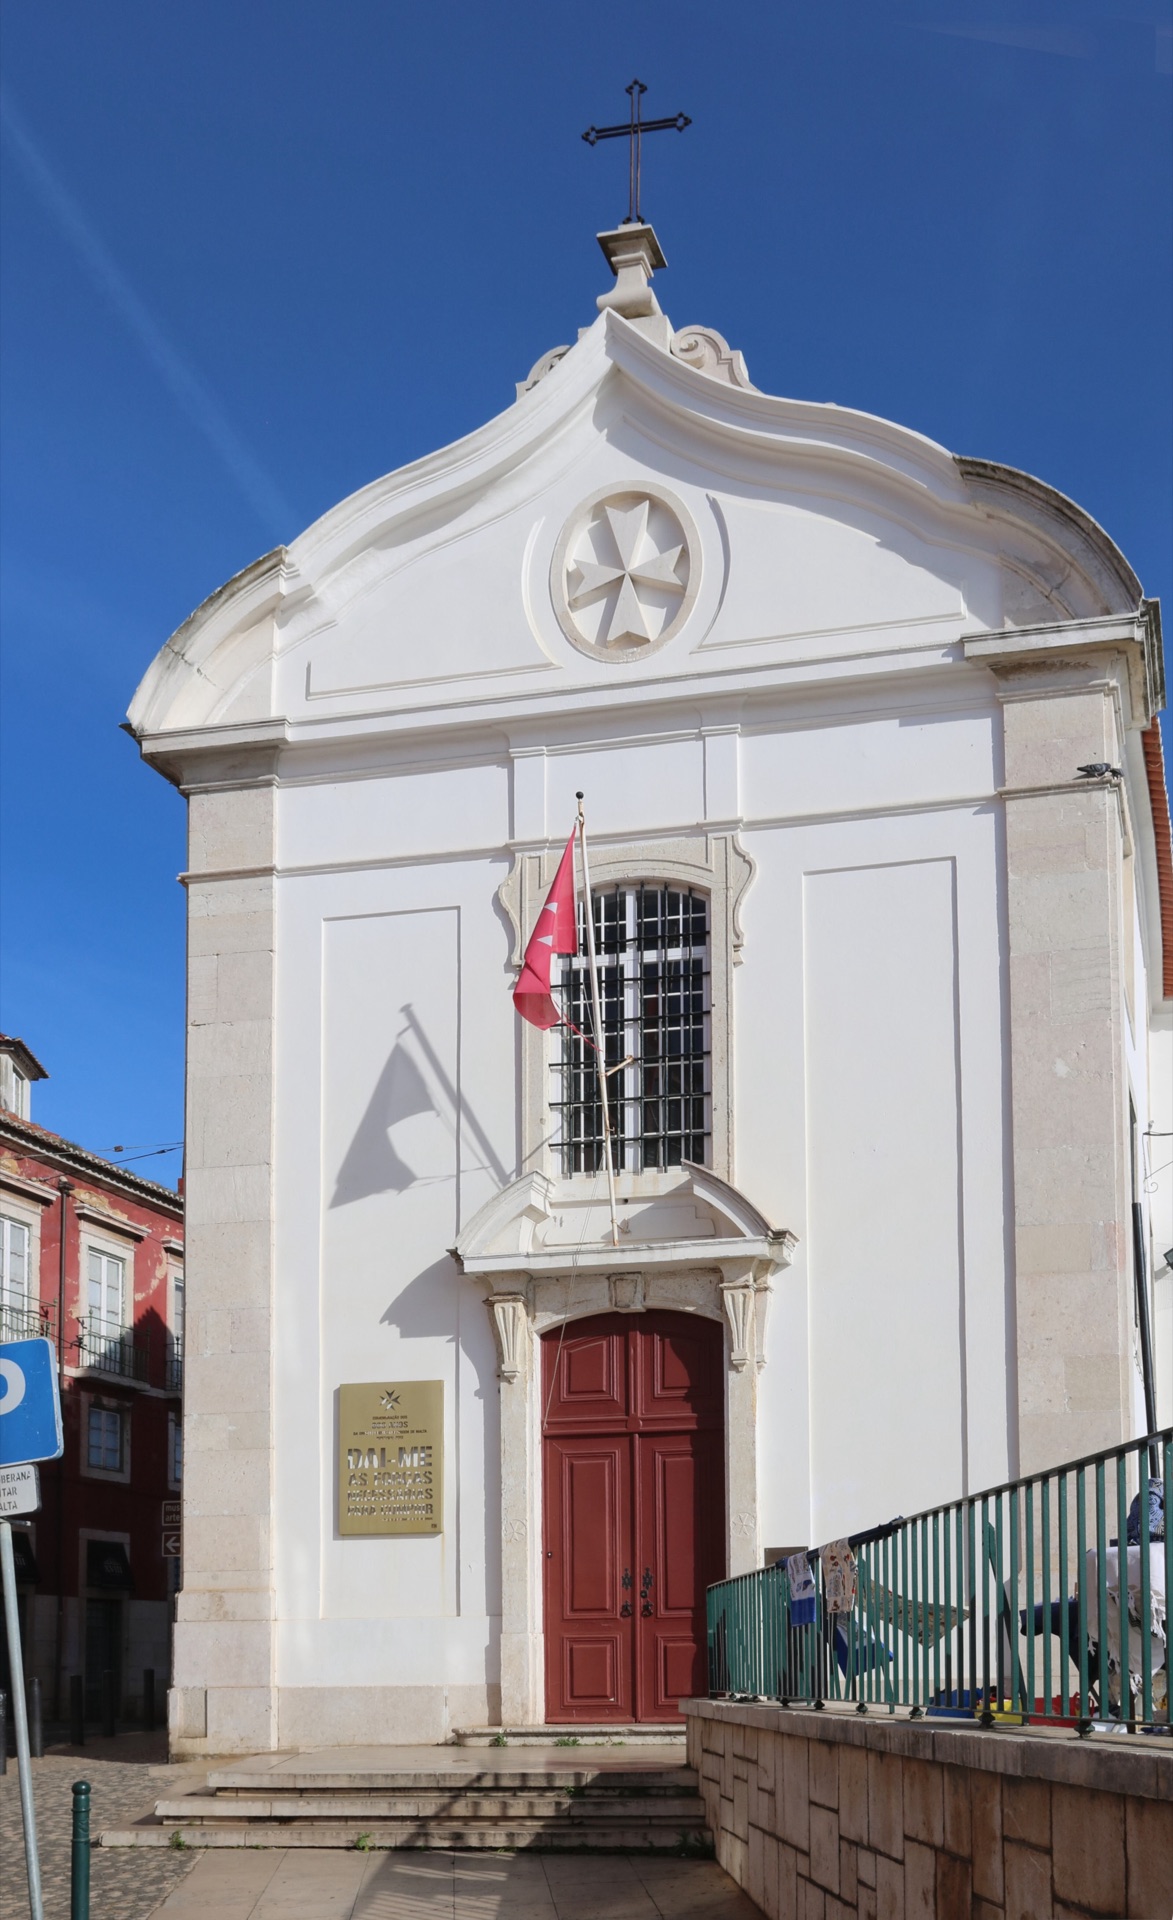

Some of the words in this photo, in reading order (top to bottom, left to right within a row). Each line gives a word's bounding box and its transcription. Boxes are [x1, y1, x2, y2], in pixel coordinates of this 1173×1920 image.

[347, 1446, 433, 1469] DAI-ME
[348, 1472, 368, 1486] AS
[373, 1471, 433, 1487] FORÇAS
[347, 1505, 376, 1516] PARA
[380, 1504, 433, 1516] CUMPRIR
